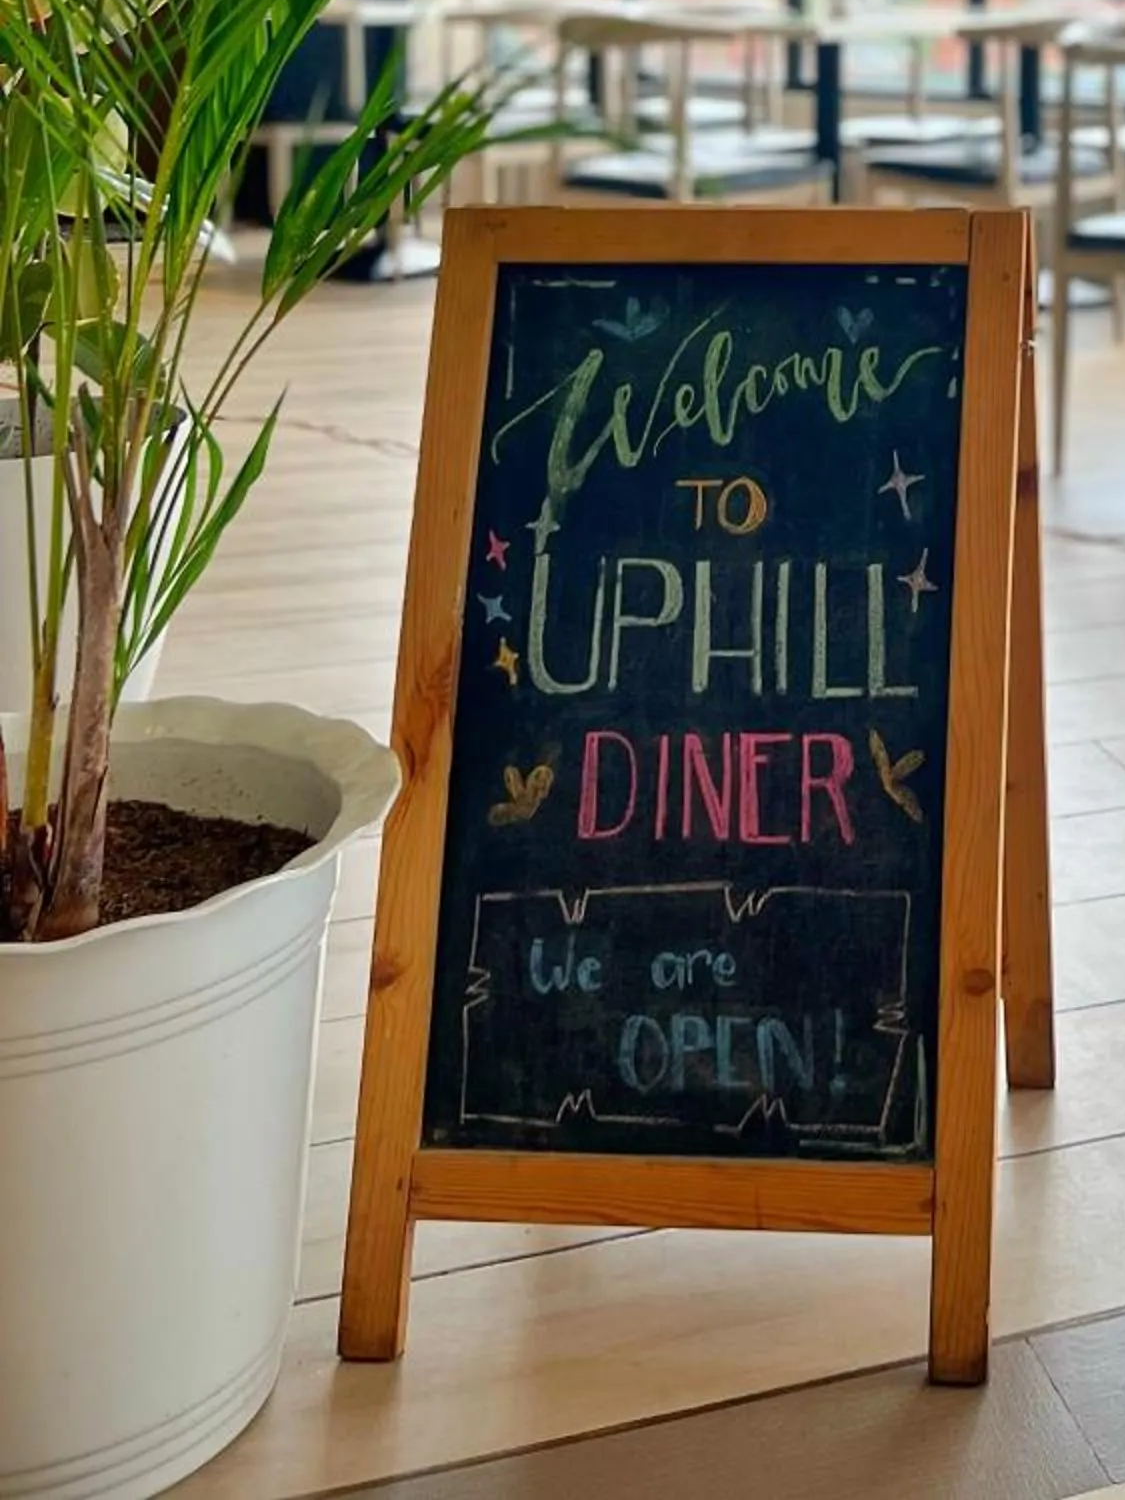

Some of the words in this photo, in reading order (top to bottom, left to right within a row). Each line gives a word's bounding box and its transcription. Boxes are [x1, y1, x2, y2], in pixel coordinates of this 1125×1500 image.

[493, 304, 942, 500] Welcome
[675, 476, 768, 535] TO
[527, 554, 919, 700] UPHILL
[577, 730, 855, 845] DINER
[529, 936, 602, 994] We
[650, 949, 738, 988] are
[617, 1008, 848, 1093] OPEN!
